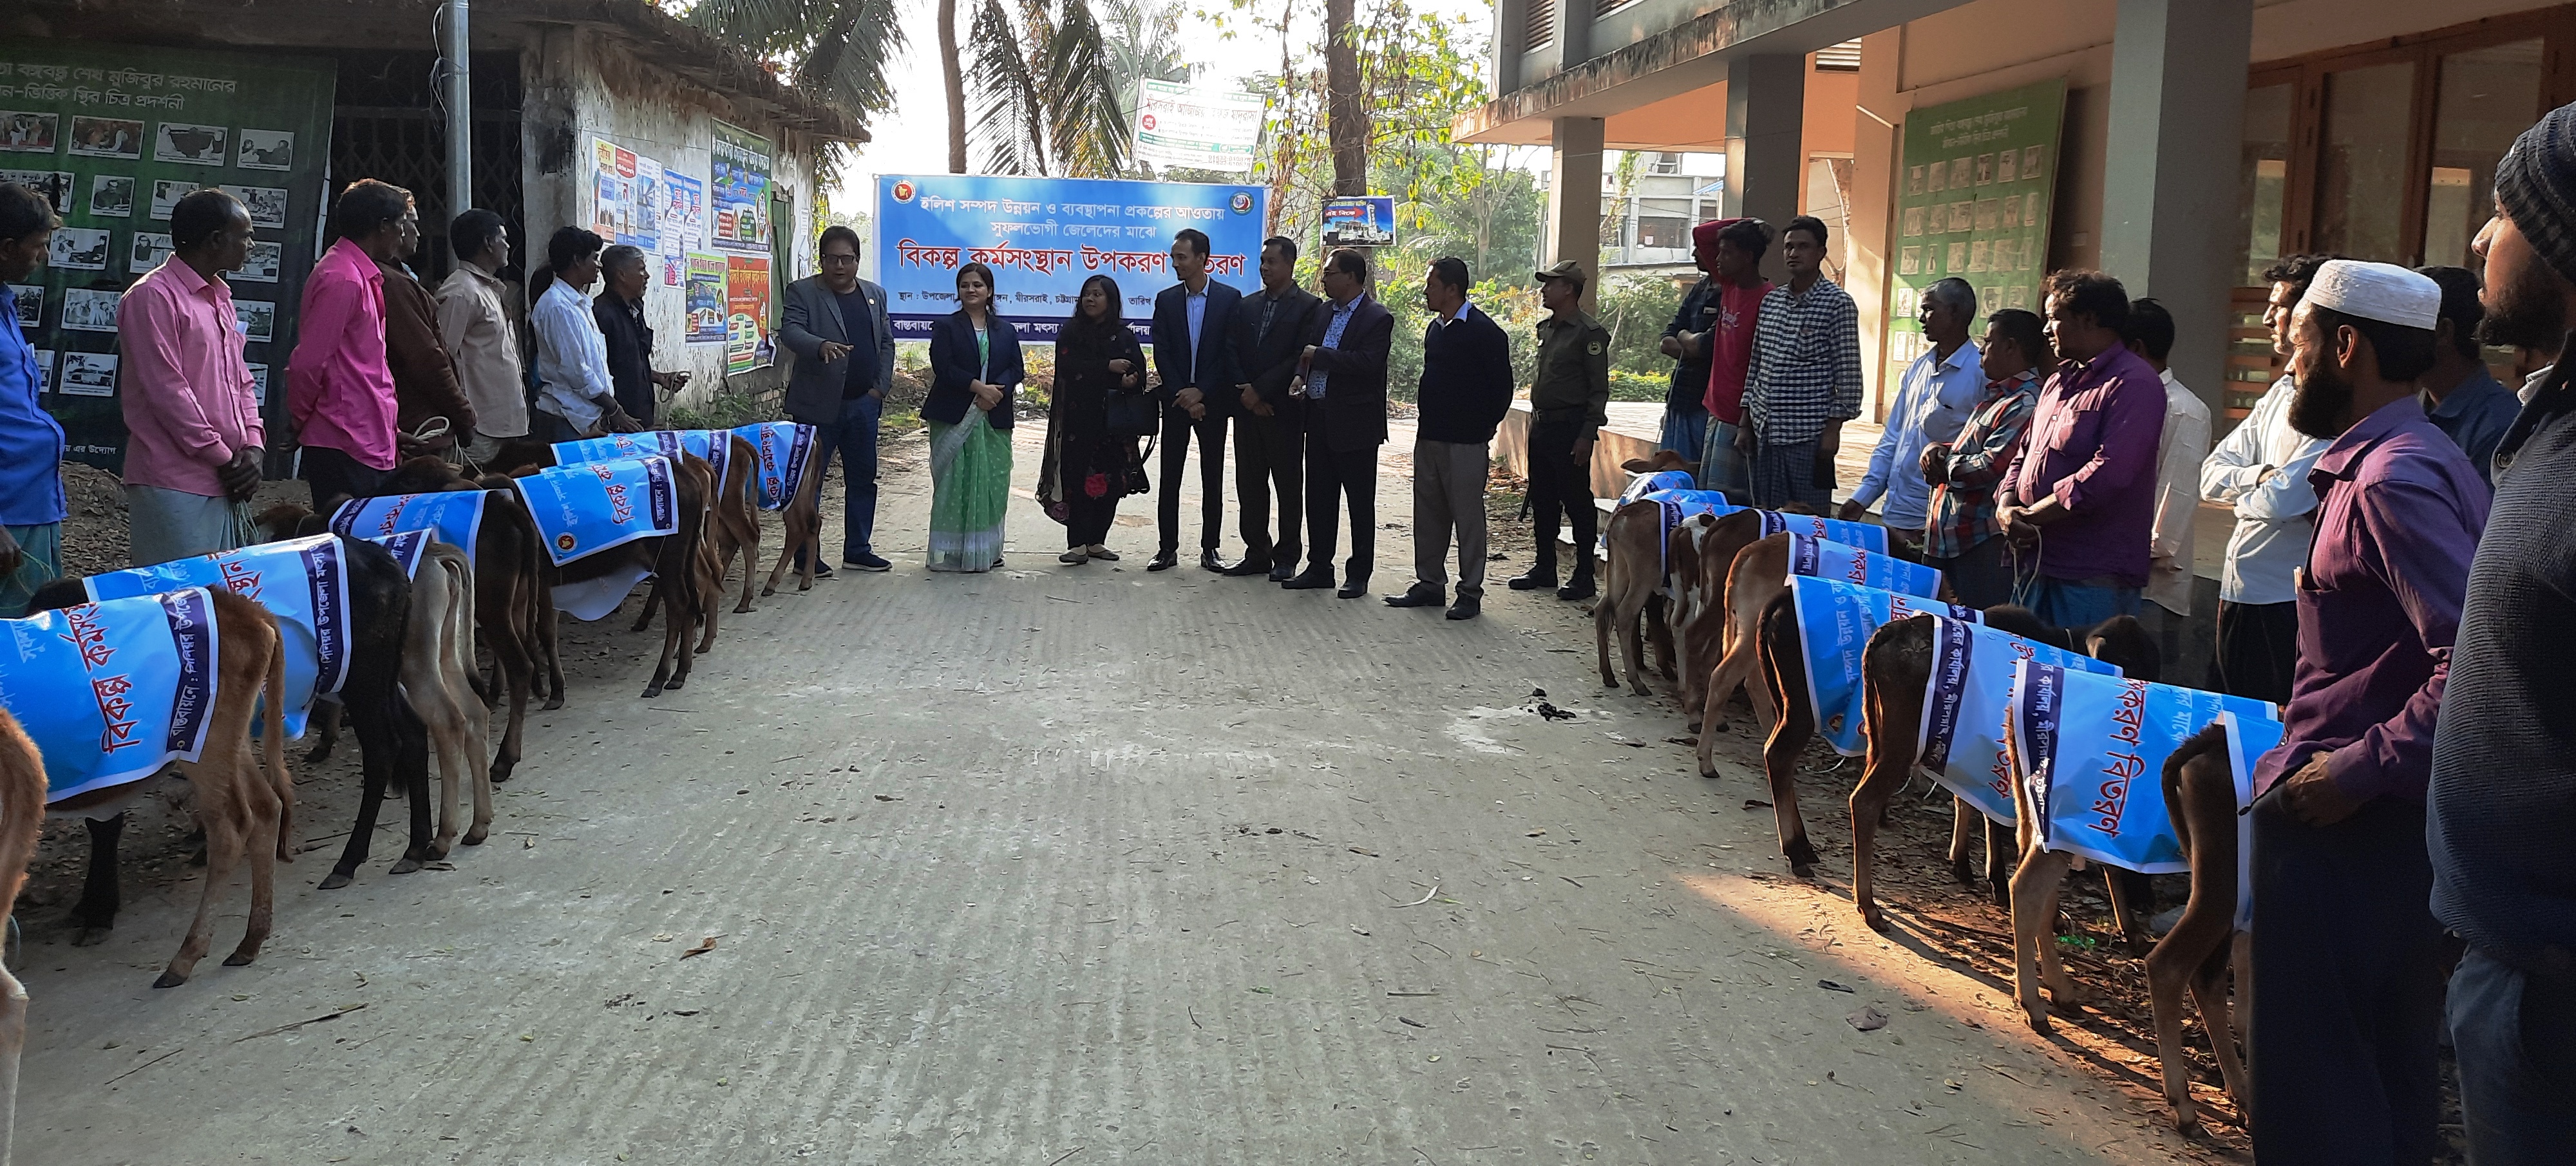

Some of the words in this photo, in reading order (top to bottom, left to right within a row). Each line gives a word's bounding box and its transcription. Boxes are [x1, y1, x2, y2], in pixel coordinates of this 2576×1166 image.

[0, 82, 68, 100] ন-ভিত্তিক
[73, 86, 100, 106] স্থির
[104, 89, 131, 106] চিত্র
[135, 93, 185, 110] প্রদর্শনী
[17, 64, 69, 82] বঙ্গবন্ধু
[73, 66, 104, 80] শেখ
[108, 68, 164, 89] মুজিবুর
[169, 75, 236, 93] রহমানের
[920, 195, 956, 212] ইলিশ
[960, 200, 998, 214] সম্পদ
[1001, 197, 1041, 216] উন্নয়ন
[1045, 203, 1056, 214] ও
[1061, 203, 1121, 220] ব্যবস্থাপনা
[1124, 205, 1173, 220] প্রকল্পের
[1175, 206, 1226, 221] আওতায়
[990, 219, 1059, 238] সুফলভোগী
[1063, 224, 1121, 238] জেলেদের
[1126, 226, 1157, 239] মাঝে
[897, 238, 961, 270] বিকল্প
[967, 240, 1074, 276] কর্মসংস্থান
[1080, 243, 1169, 274] উপকরণ
[1204, 254, 1246, 276] তরণ
[898, 292, 913, 301] স্থান
[922, 290, 955, 301] উপজেলা
[605, 483, 635, 525] বিকল্প
[315, 581, 331, 625] উপজেলা
[91, 673, 141, 755] বিকল্প
[170, 685, 200, 737] বাস্তবায়নে
[2085, 751, 2145, 840] বিতরণ
